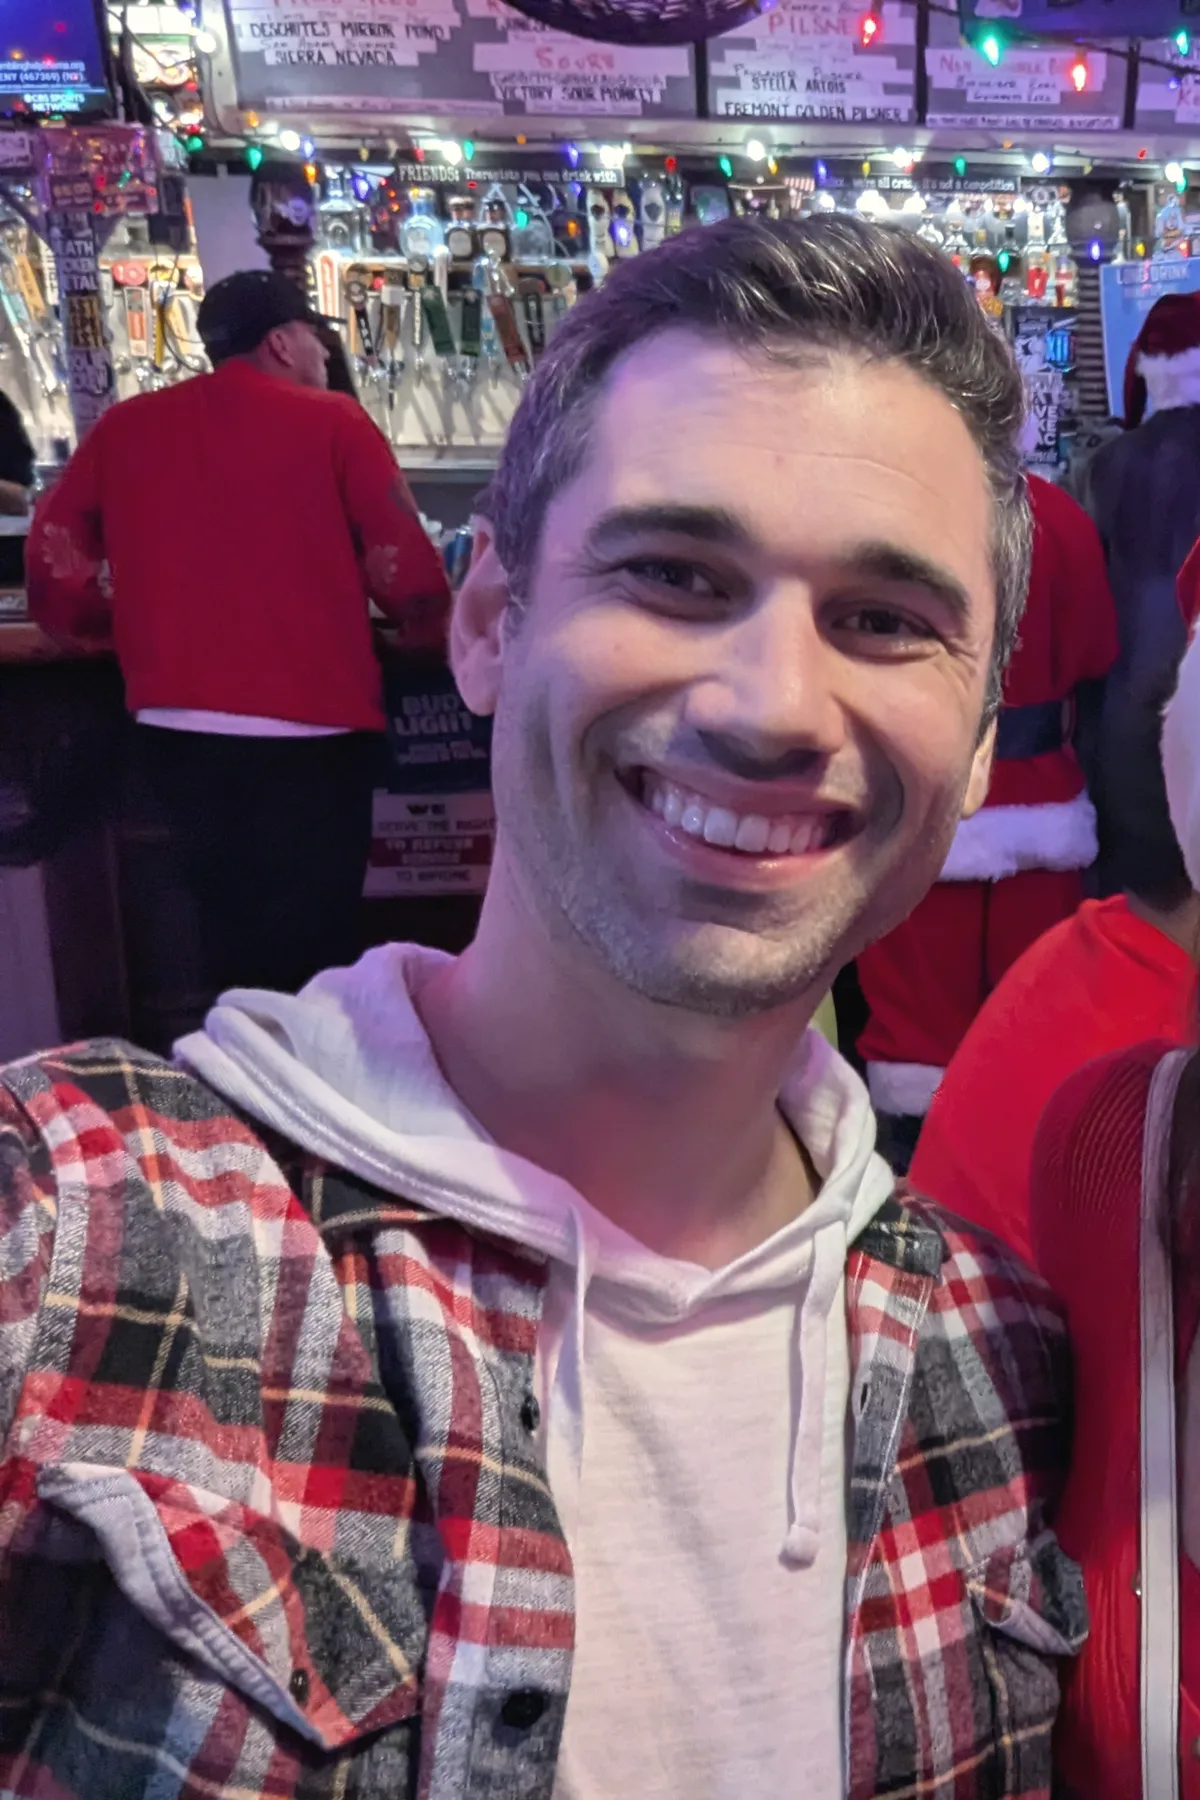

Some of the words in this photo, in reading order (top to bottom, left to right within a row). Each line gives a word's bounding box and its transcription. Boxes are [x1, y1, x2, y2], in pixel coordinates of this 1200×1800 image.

[341, 22, 396, 38] MIRROR
[274, 52, 328, 66] SIERRA
[336, 52, 397, 66] NEVADA
[751, 77, 798, 92] STELLA
[805, 79, 847, 94] ARTOIS
[724, 101, 790, 117] FREMONT
[400, 164, 460, 182] FRIENDS:
[402, 694, 460, 715] BUD
[394, 710, 474, 736] LIGHT
[405, 804, 446, 816] WE
